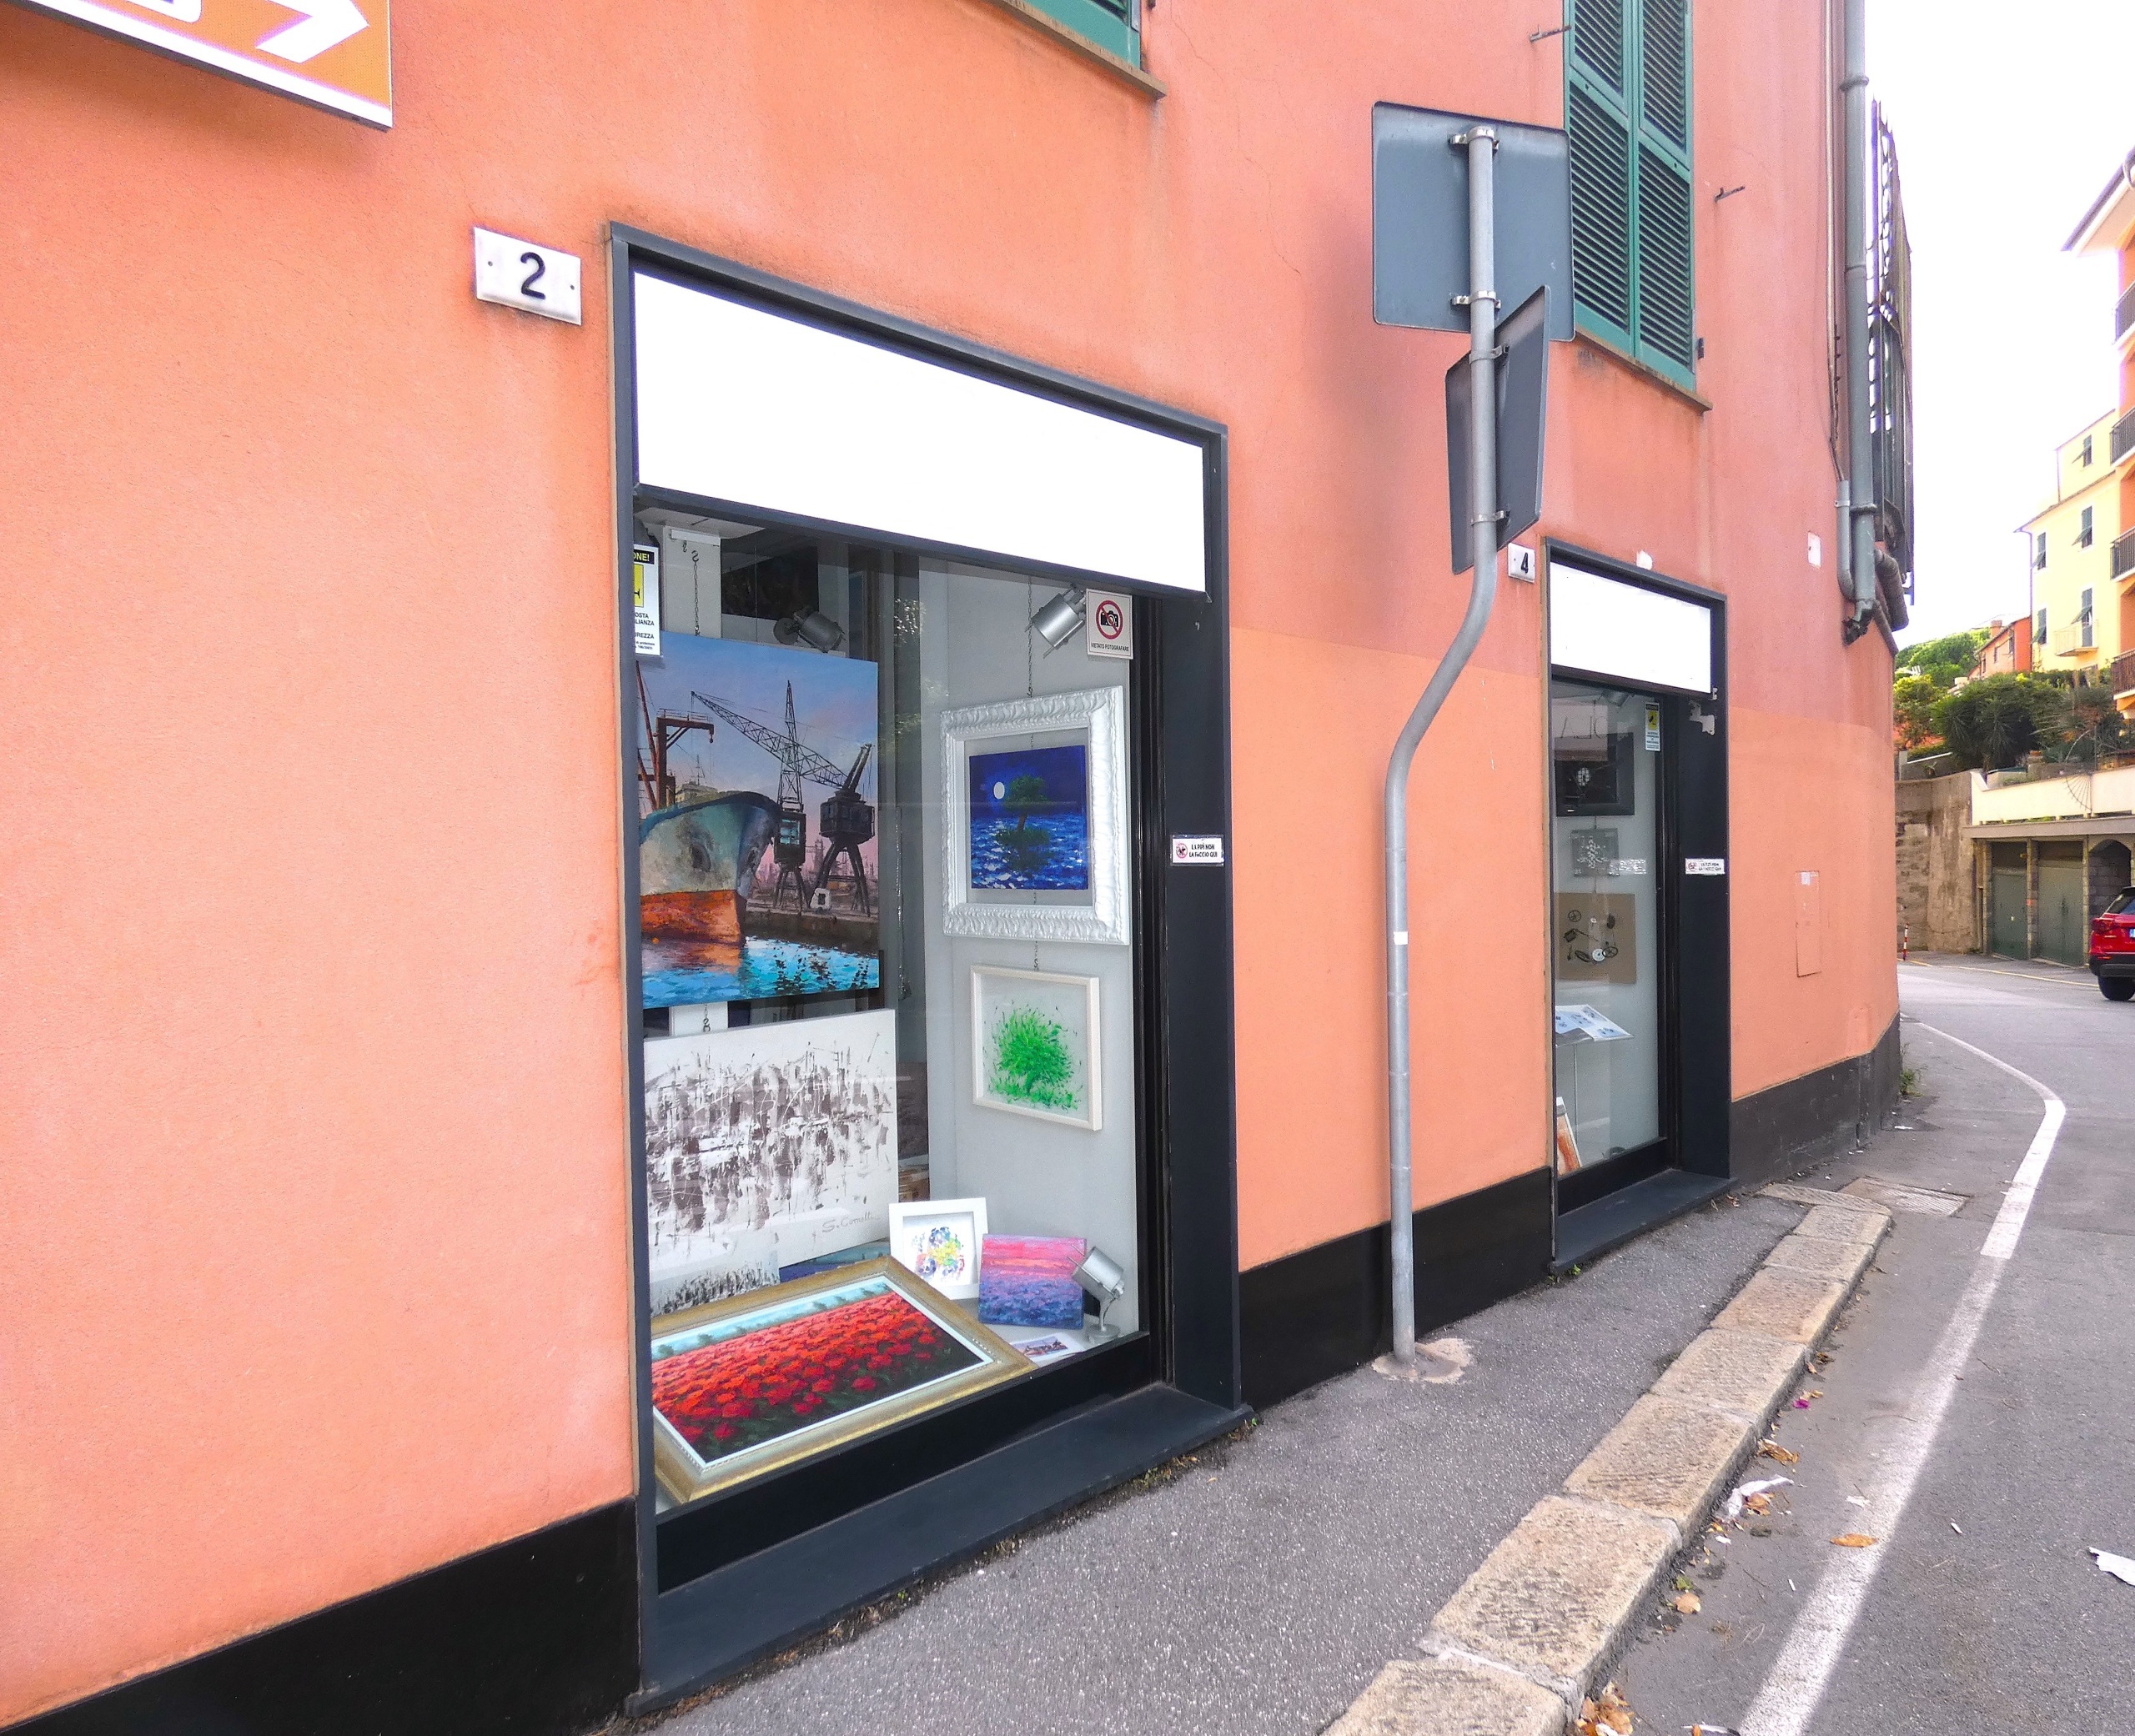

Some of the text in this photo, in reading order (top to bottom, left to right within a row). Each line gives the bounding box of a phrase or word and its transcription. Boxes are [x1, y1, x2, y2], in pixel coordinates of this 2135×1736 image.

[520, 252, 546, 300] 2
[1520, 552, 1529, 574] 4
[1105, 644, 1129, 652] FOTOGRAFARE
